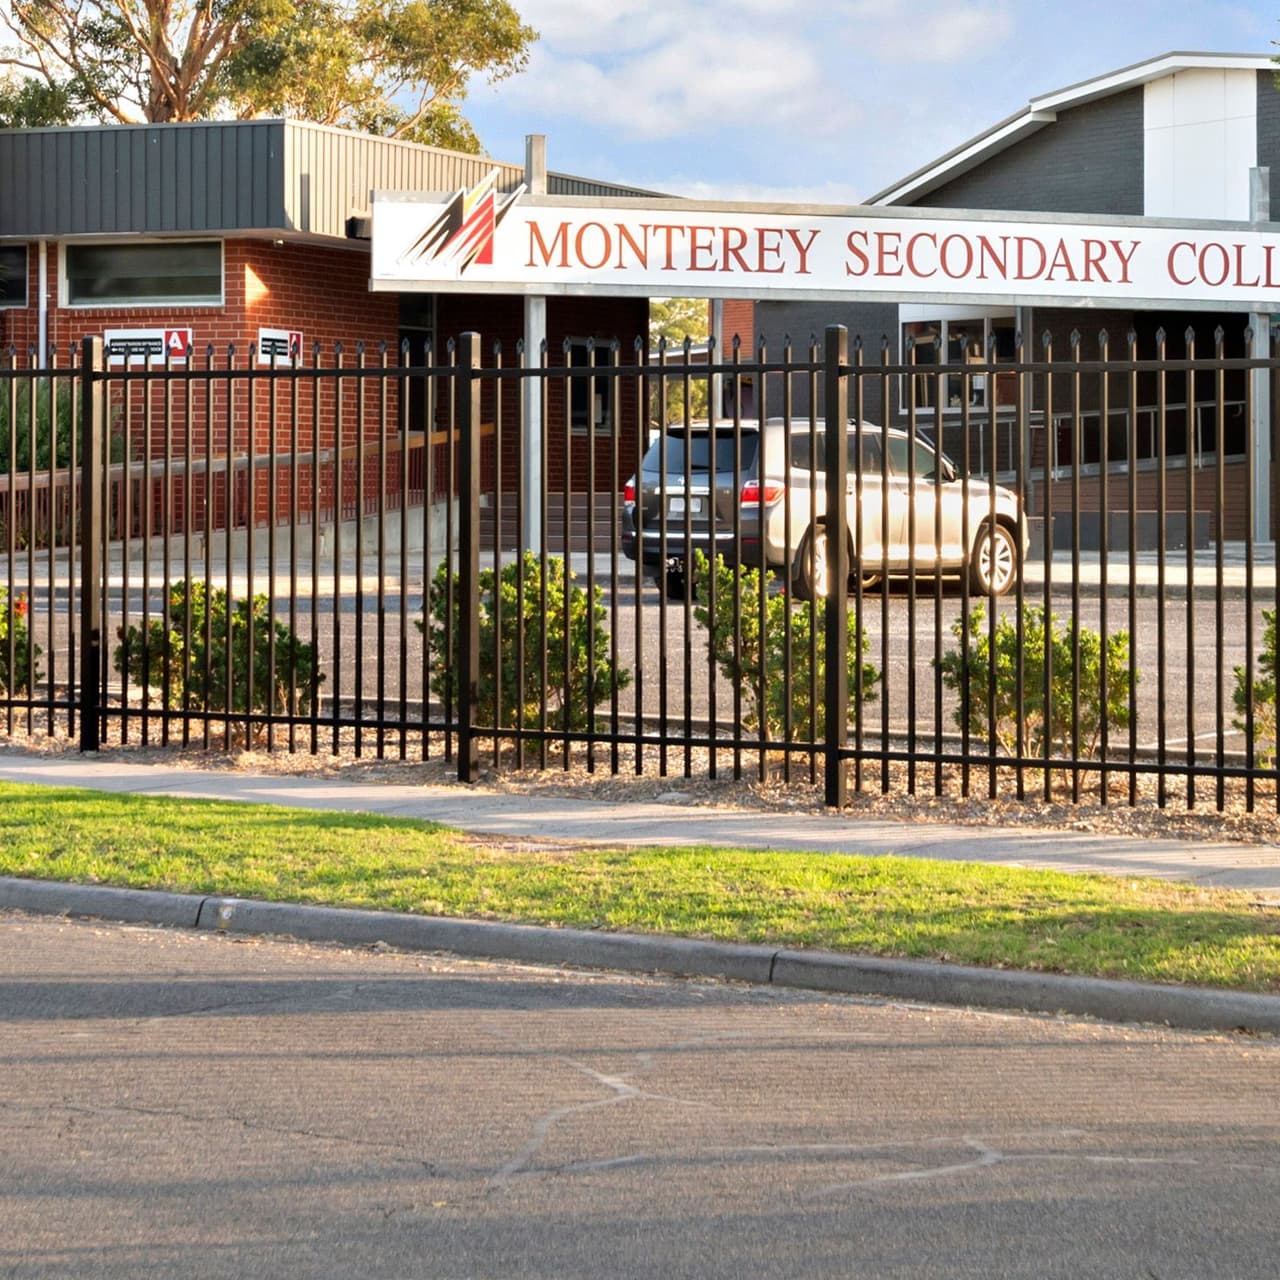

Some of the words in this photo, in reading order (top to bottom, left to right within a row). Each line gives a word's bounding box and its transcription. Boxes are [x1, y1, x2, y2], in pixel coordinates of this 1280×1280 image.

[525, 220, 821, 274] MONTEREY
[845, 230, 1141, 284] SECONDARY
[168, 331, 184, 351] A
